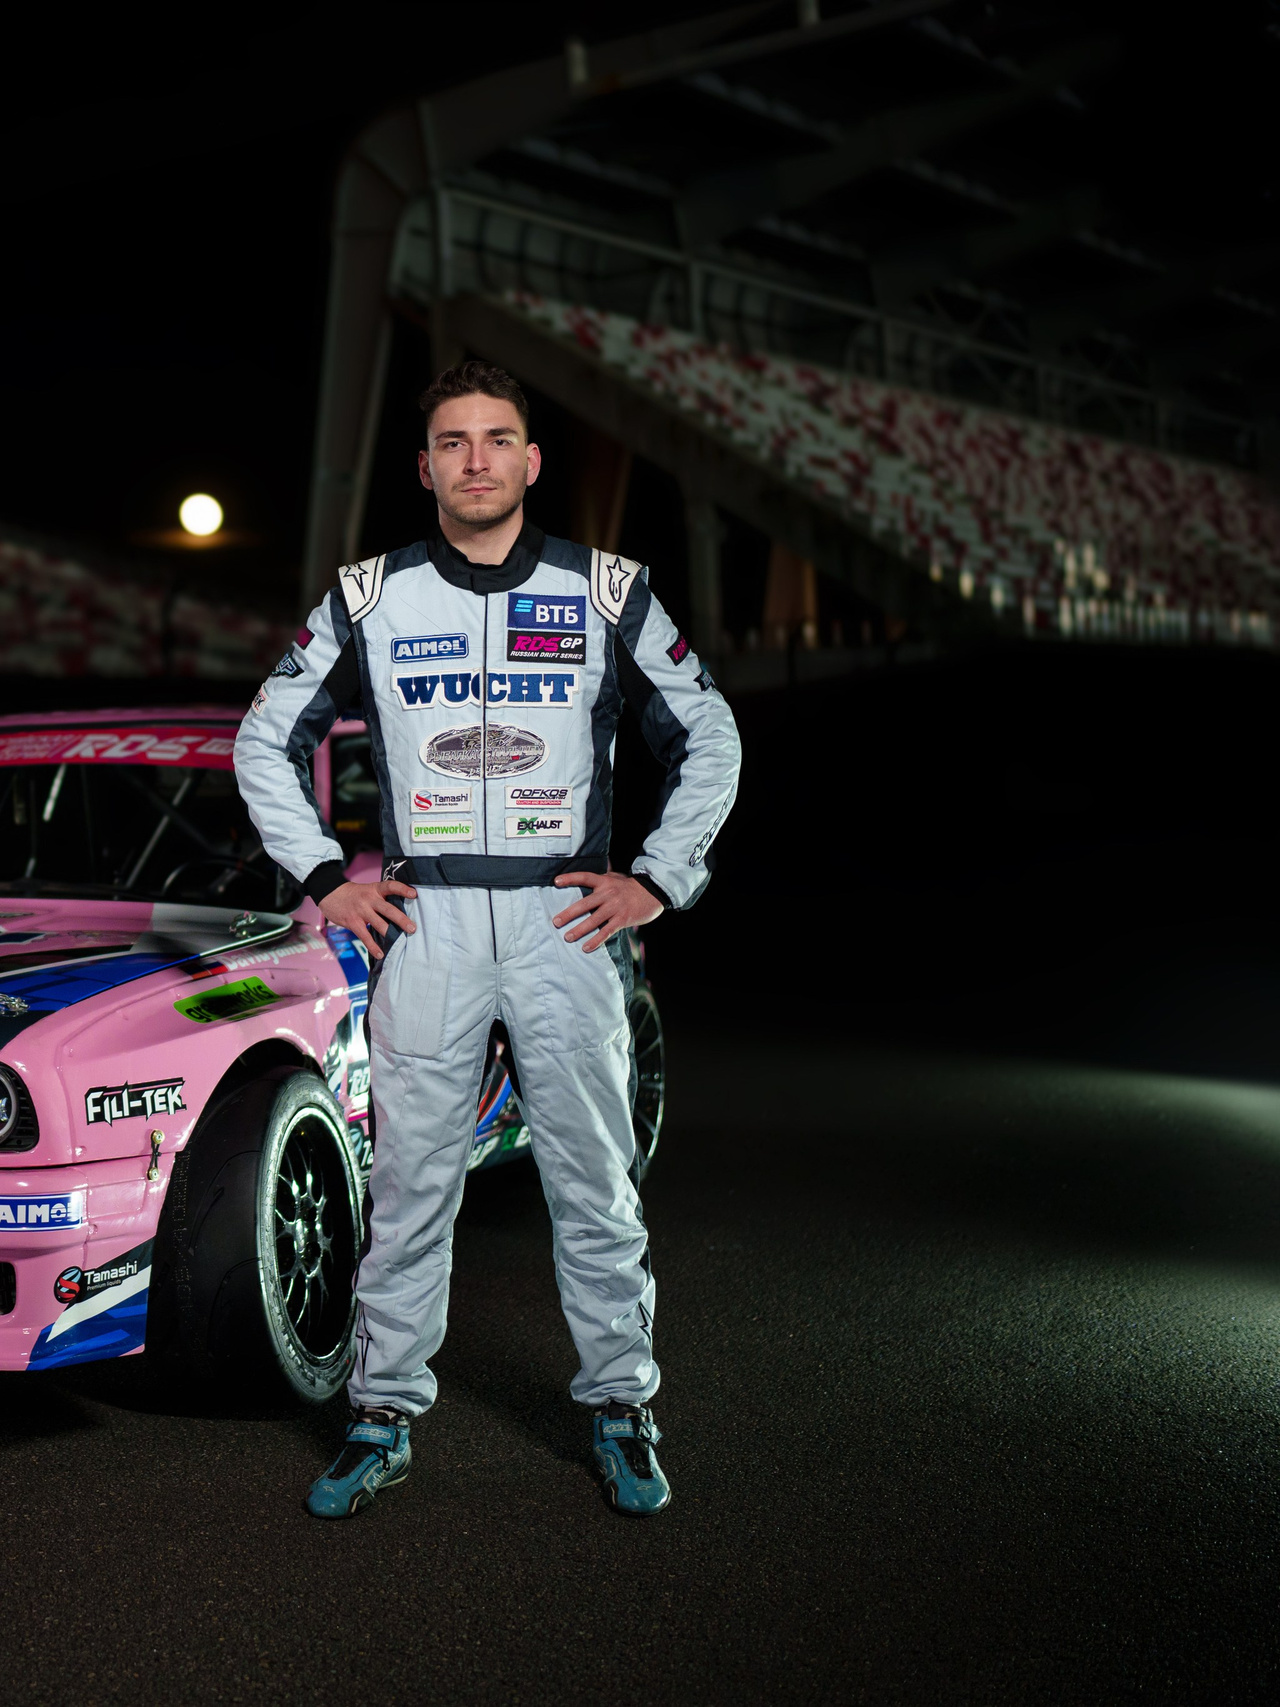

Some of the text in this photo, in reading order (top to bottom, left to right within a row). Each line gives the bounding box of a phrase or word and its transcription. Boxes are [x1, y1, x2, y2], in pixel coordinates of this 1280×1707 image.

[535, 604, 579, 624] ВТБ
[513, 635, 584, 652] RDS GP
[397, 672, 575, 705] WUCHT
[62, 734, 206, 761] RDS
[432, 793, 468, 803] Tamashi
[414, 823, 470, 837] greenworks
[517, 818, 563, 833] EXHAUST
[84, 1261, 138, 1284] Tamashi
[87, 1279, 122, 1291] Premium liquids
